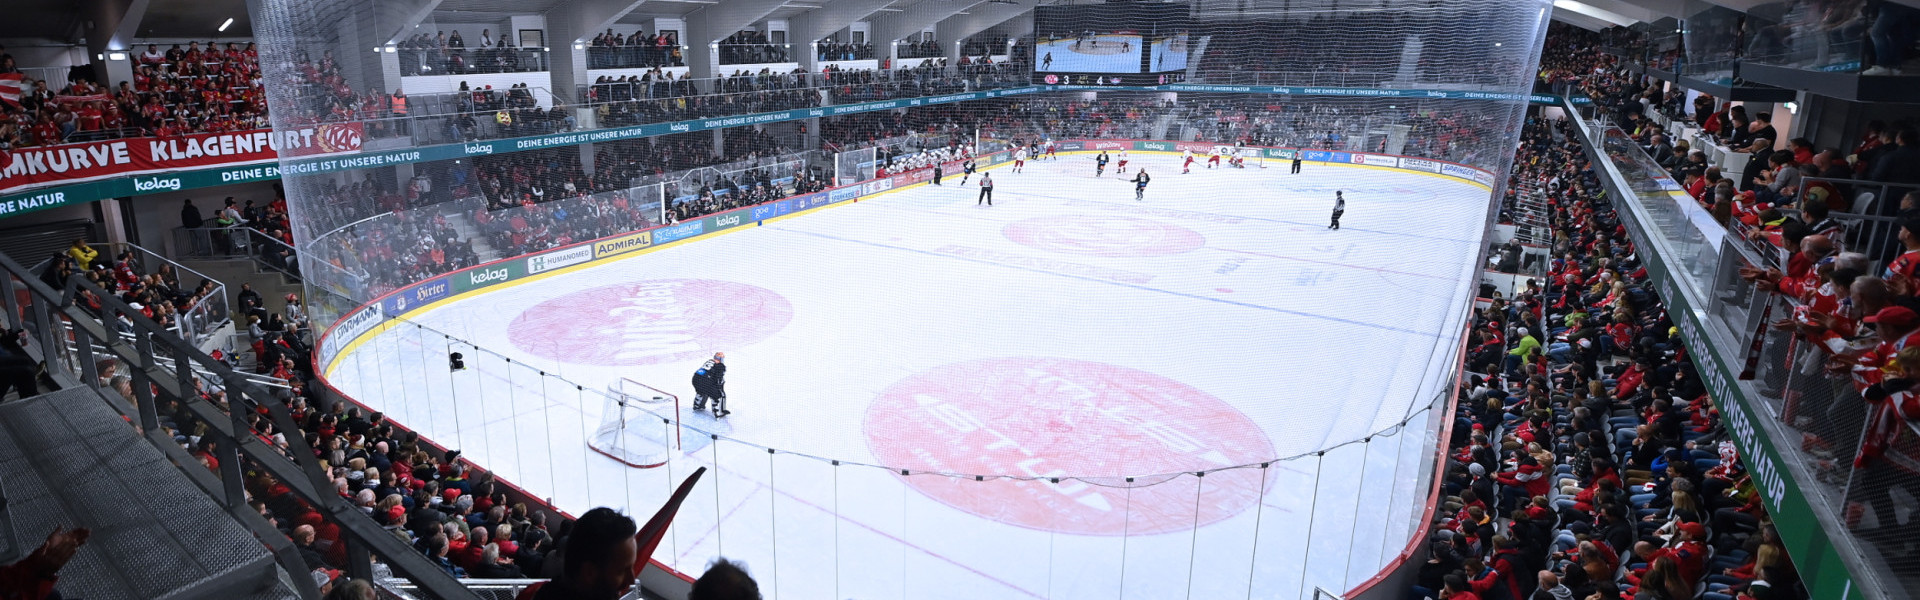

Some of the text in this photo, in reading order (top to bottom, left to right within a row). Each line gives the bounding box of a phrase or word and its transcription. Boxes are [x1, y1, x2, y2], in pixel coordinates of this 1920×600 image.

[1063, 76, 1070, 85] 3
[1096, 76, 1104, 85] 4
[705, 120, 722, 128] DEINE
[722, 118, 745, 126] ENERGIE
[149, 128, 314, 162] KLAGENFURT
[517, 128, 642, 149] DEINE ENERGIE IST UNSERE NATUR
[464, 143, 493, 155] kelag
[0, 141, 131, 181] MKURVE
[221, 151, 420, 182] DEINE ENERGIE IST UNSERE NATUR
[1443, 164, 1475, 176] SPRINGER
[134, 177, 181, 192] kelag
[18, 192, 65, 211] NATUR
[716, 215, 740, 228] kelag
[597, 235, 649, 255] ADMIRAL
[547, 249, 589, 265] HUMANOMED
[470, 267, 508, 285] kelag
[417, 281, 445, 301] Hirter
[1680, 308, 1785, 514] DEINE ENERGIE IST UNSERE NATUR
